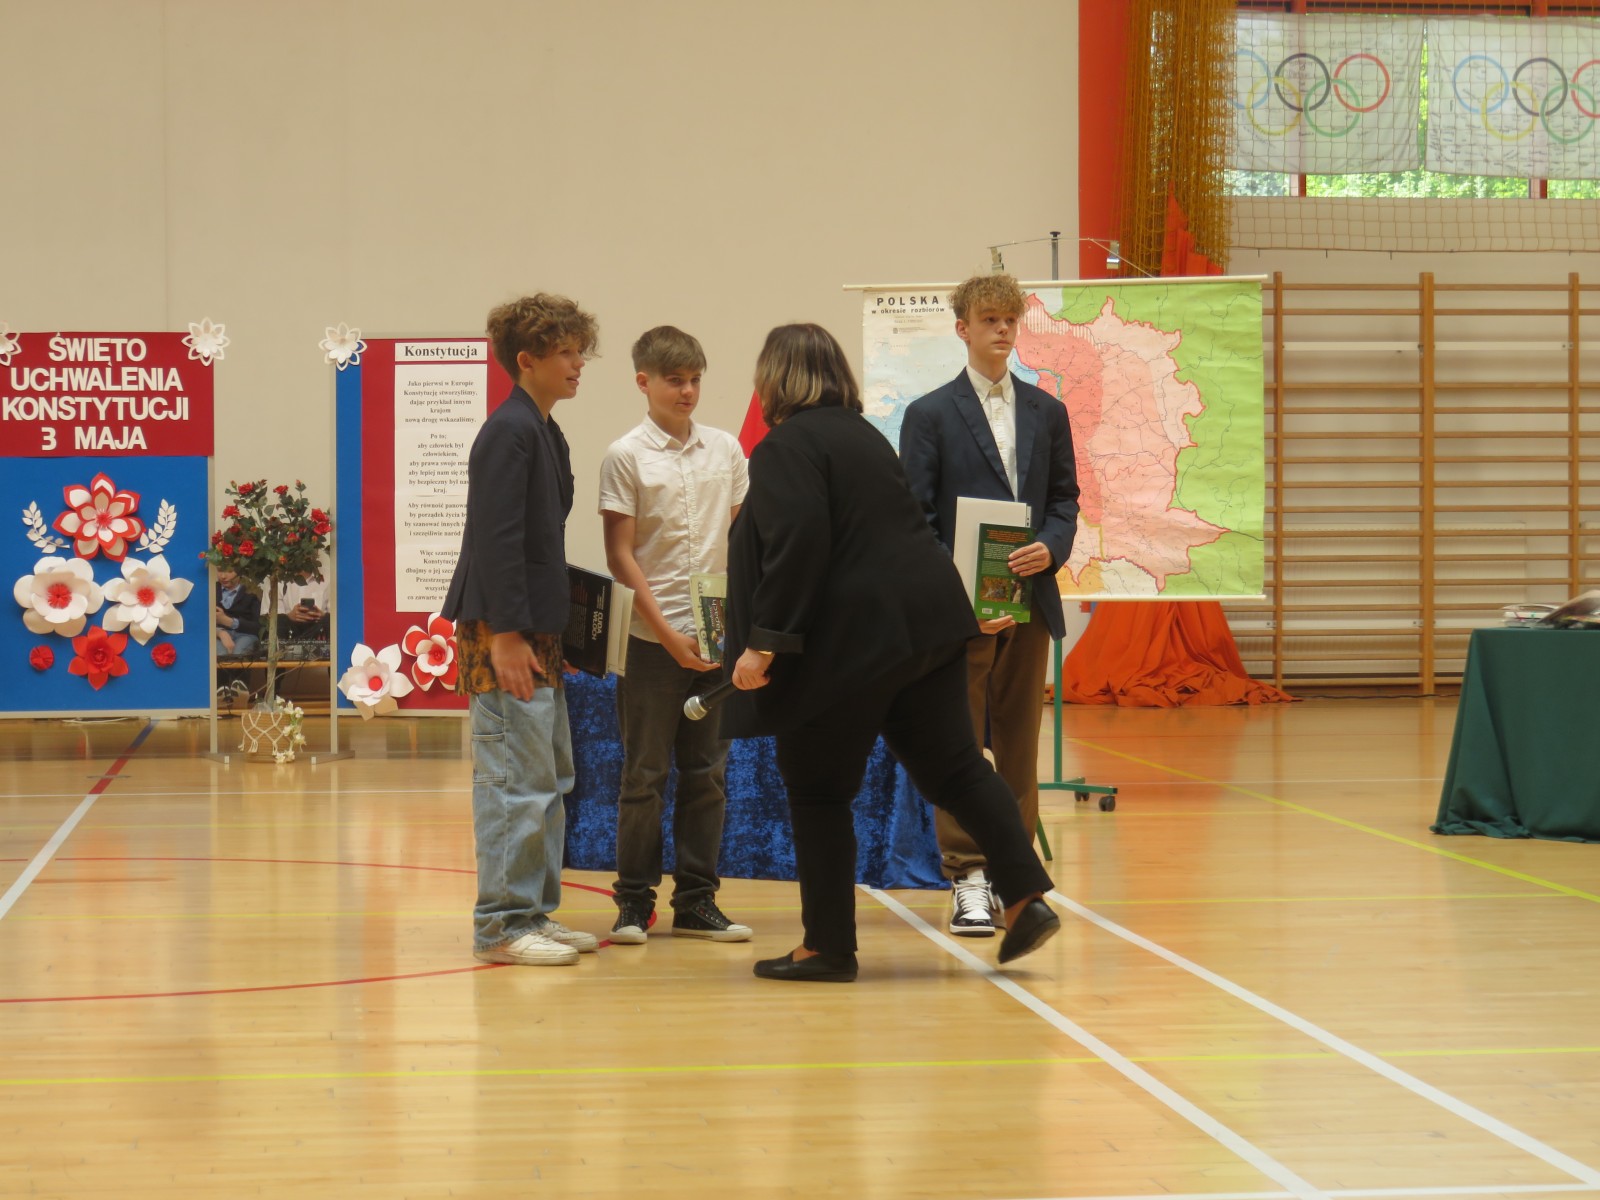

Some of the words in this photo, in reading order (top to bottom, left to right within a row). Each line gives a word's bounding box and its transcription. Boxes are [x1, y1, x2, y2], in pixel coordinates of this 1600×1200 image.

[876, 295, 939, 306] POLSKA
[48, 332, 147, 366] ŚWIĘTO
[404, 345, 478, 359] Konstytucja
[10, 366, 184, 392] UCHWALENIA
[2, 396, 189, 421] KONSTYTUCJI
[41, 427, 57, 451] 3
[74, 426, 147, 450] MAJA
